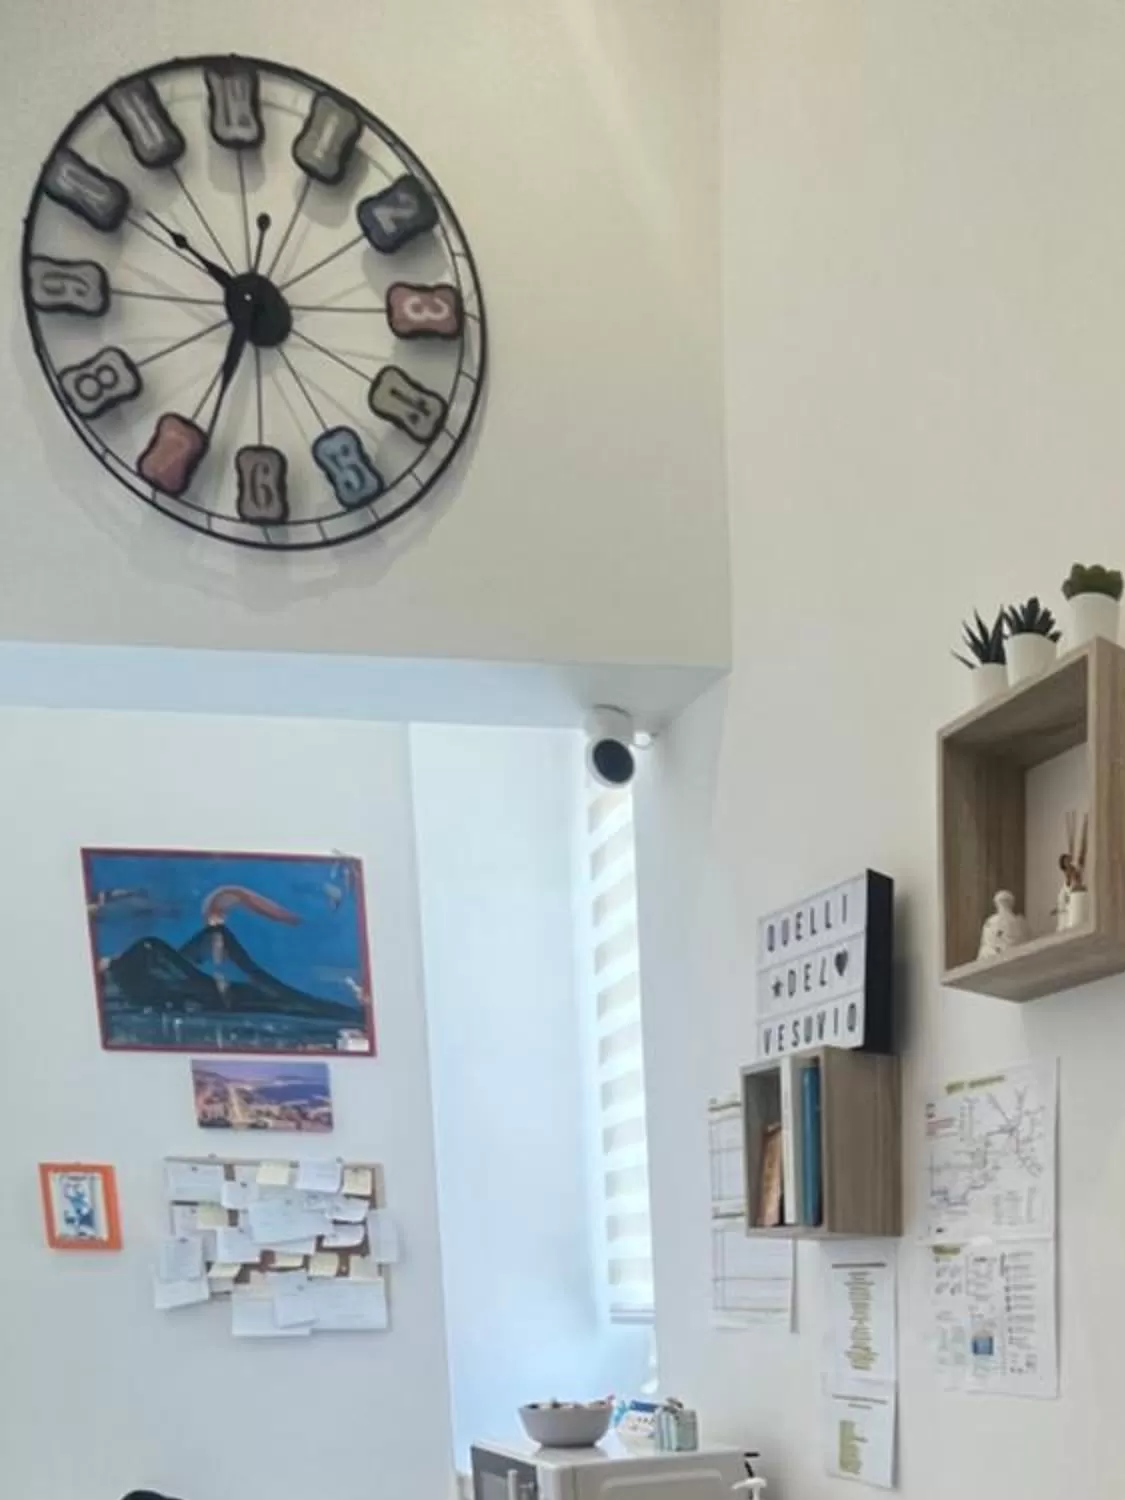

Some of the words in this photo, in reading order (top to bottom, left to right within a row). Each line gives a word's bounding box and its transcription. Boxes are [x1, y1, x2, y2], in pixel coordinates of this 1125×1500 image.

[402, 296, 449, 322] 3
[74, 363, 120, 402] 8
[765, 893, 849, 953] QUELLI
[787, 956, 828, 999] DEL
[763, 1001, 858, 1056] VESUVIO
